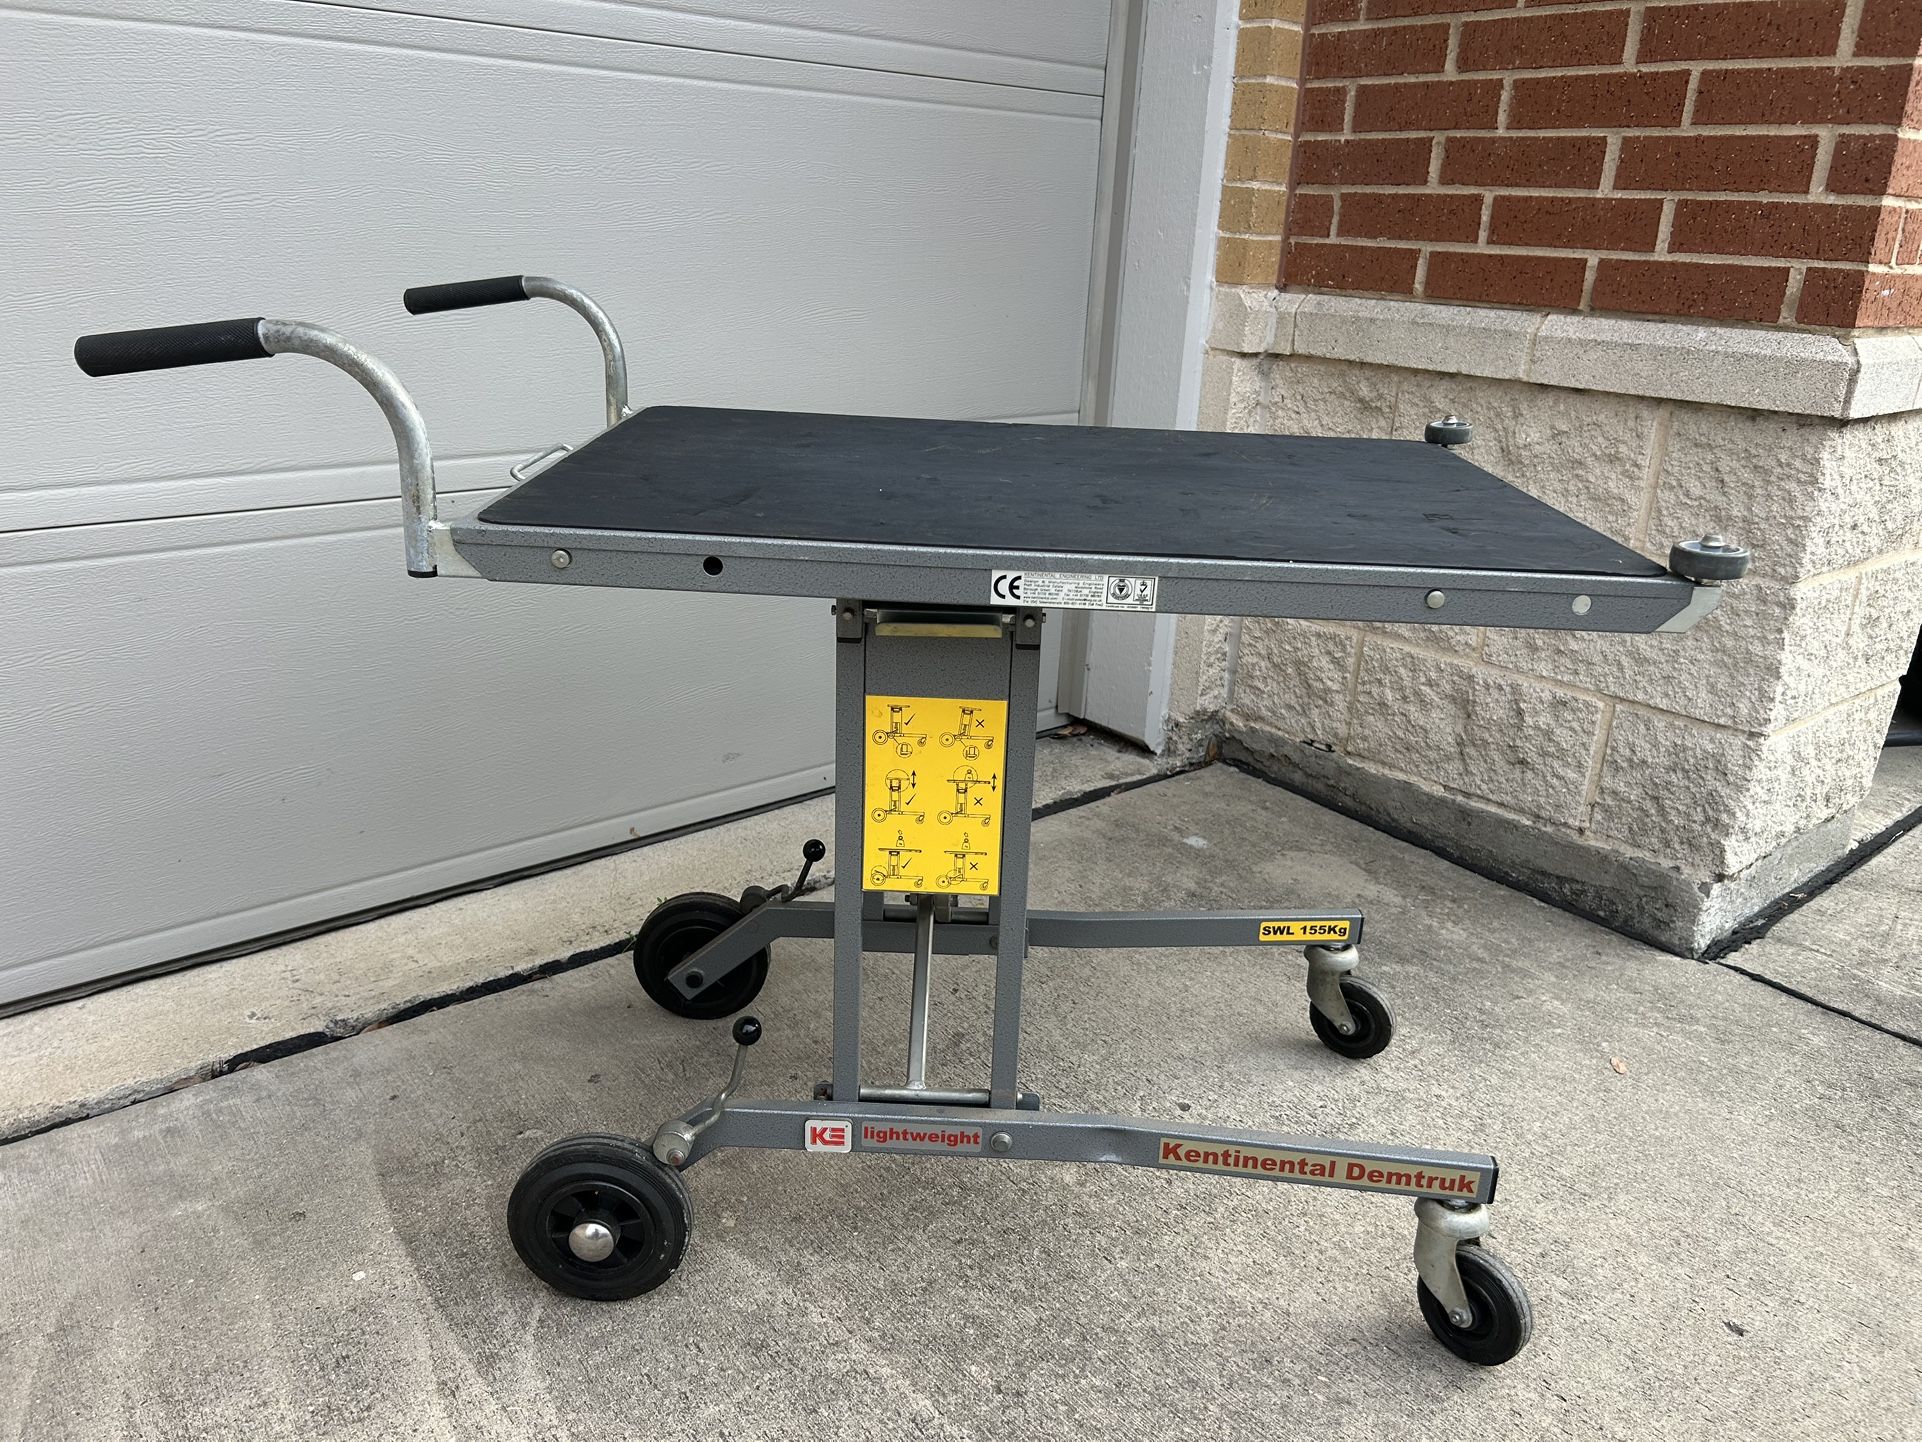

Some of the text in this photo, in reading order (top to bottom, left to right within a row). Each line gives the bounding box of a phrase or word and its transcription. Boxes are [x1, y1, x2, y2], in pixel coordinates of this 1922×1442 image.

[993, 574, 1022, 600] CE
[1262, 925, 1347, 937] SWL 155Kg
[810, 1126, 845, 1146] KE
[863, 1126, 981, 1147] lightweight
[1162, 1142, 1478, 1194] Kentinental Demtruk
